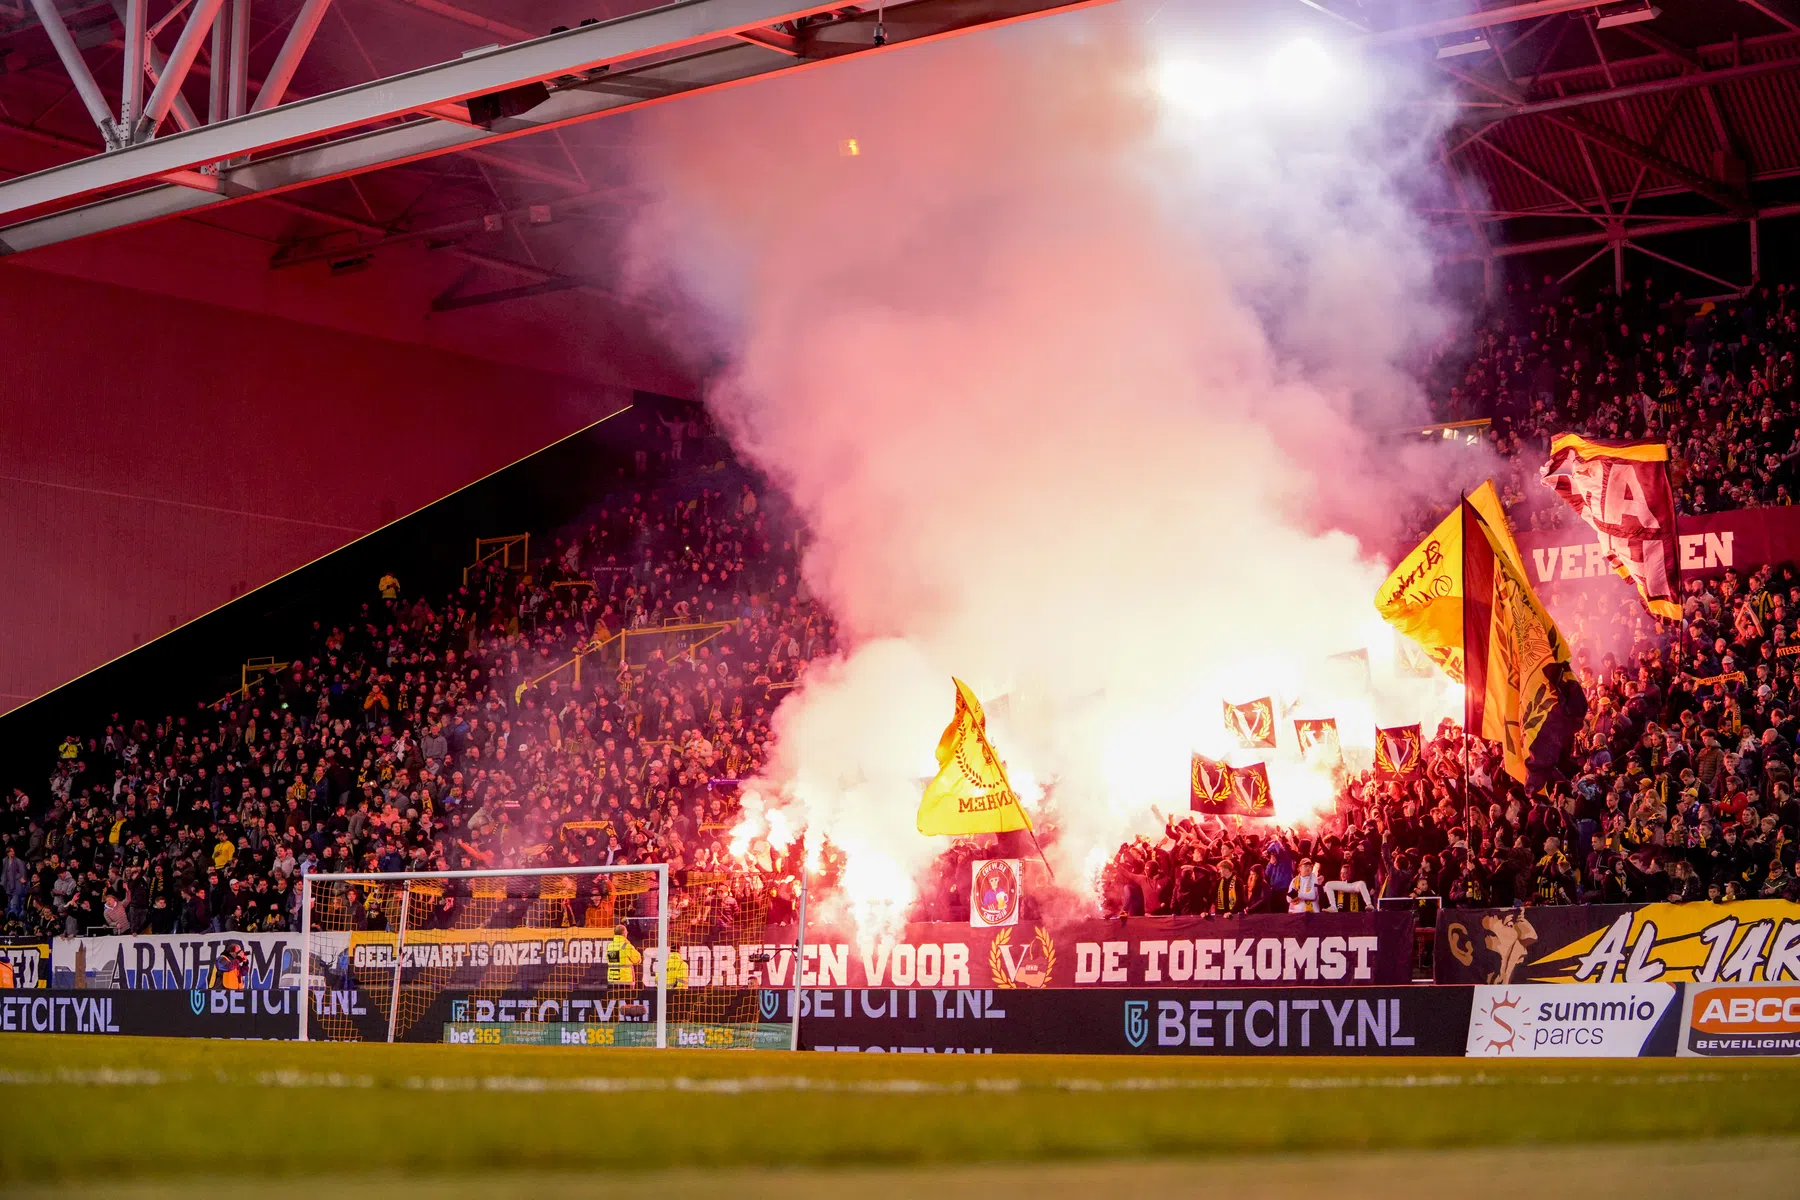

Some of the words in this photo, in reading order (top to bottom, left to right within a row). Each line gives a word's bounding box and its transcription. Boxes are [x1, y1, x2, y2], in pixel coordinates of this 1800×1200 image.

[1533, 532, 1734, 582] VEREN
[1779, 645, 1800, 657] ITESSE
[354, 944, 396, 968] GEEL
[400, 945, 463, 967] ZWART
[470, 944, 489, 966] IS
[493, 943, 542, 966] ONZE
[1075, 941, 1128, 983] DE
[1140, 936, 1378, 982] TOEKOMST
[1576, 911, 1665, 983] AL
[0, 949, 39, 988] ED
[111, 940, 287, 990] ARNHM
[642, 943, 848, 987] GDREVEN
[860, 943, 970, 986] VOOR
[0, 996, 120, 1032] ETCITY.NL
[211, 990, 367, 1015] BETCIY.NL
[1538, 995, 1655, 1021] summio
[450, 1028, 500, 1044] bet365
[561, 1027, 615, 1045] bet365
[678, 1028, 734, 1045] bet365
[1158, 999, 1415, 1047] BETCITY.NL
[1534, 1027, 1603, 1050] parcs
